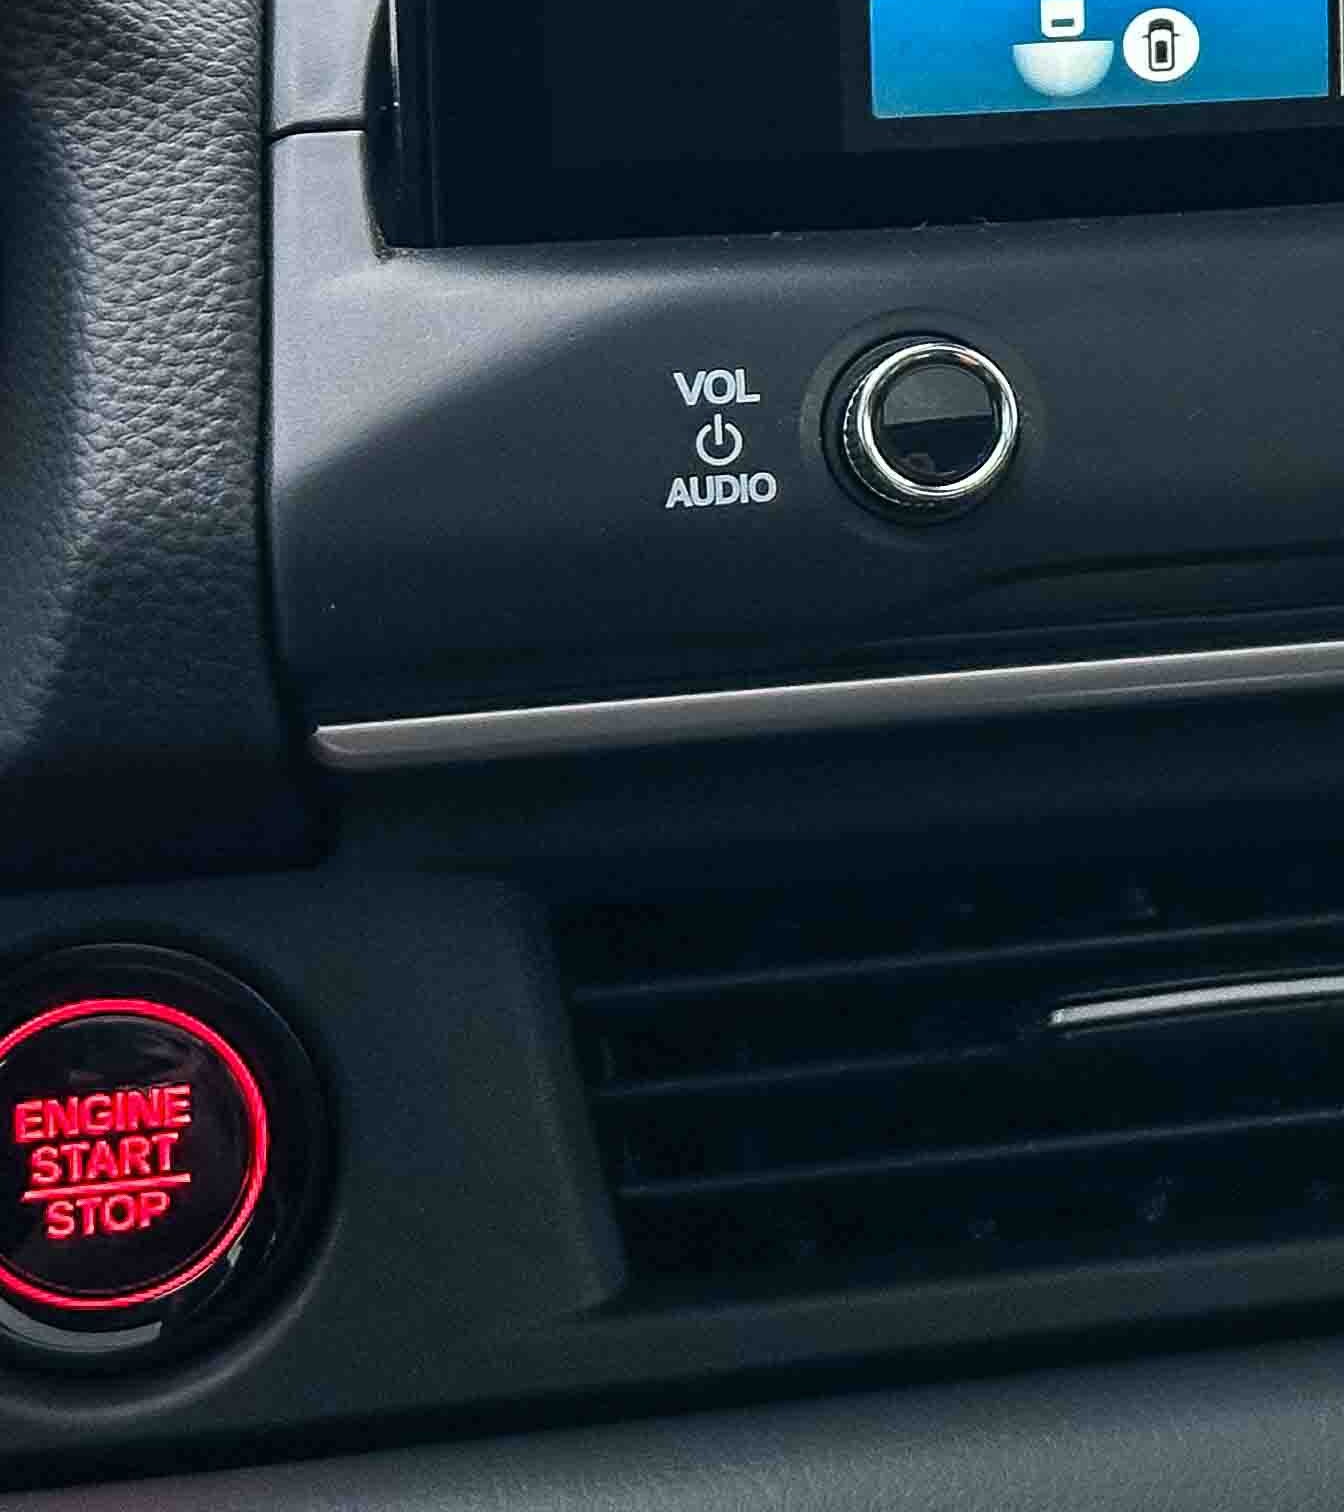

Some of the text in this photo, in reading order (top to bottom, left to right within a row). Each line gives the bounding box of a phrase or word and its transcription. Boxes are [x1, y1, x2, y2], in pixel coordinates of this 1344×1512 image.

[673, 369, 761, 406] VOL
[665, 472, 777, 509] AUDIO
[14, 1084, 191, 1143] ENGINE
[30, 1132, 179, 1184] START
[46, 1191, 171, 1239] STOP
